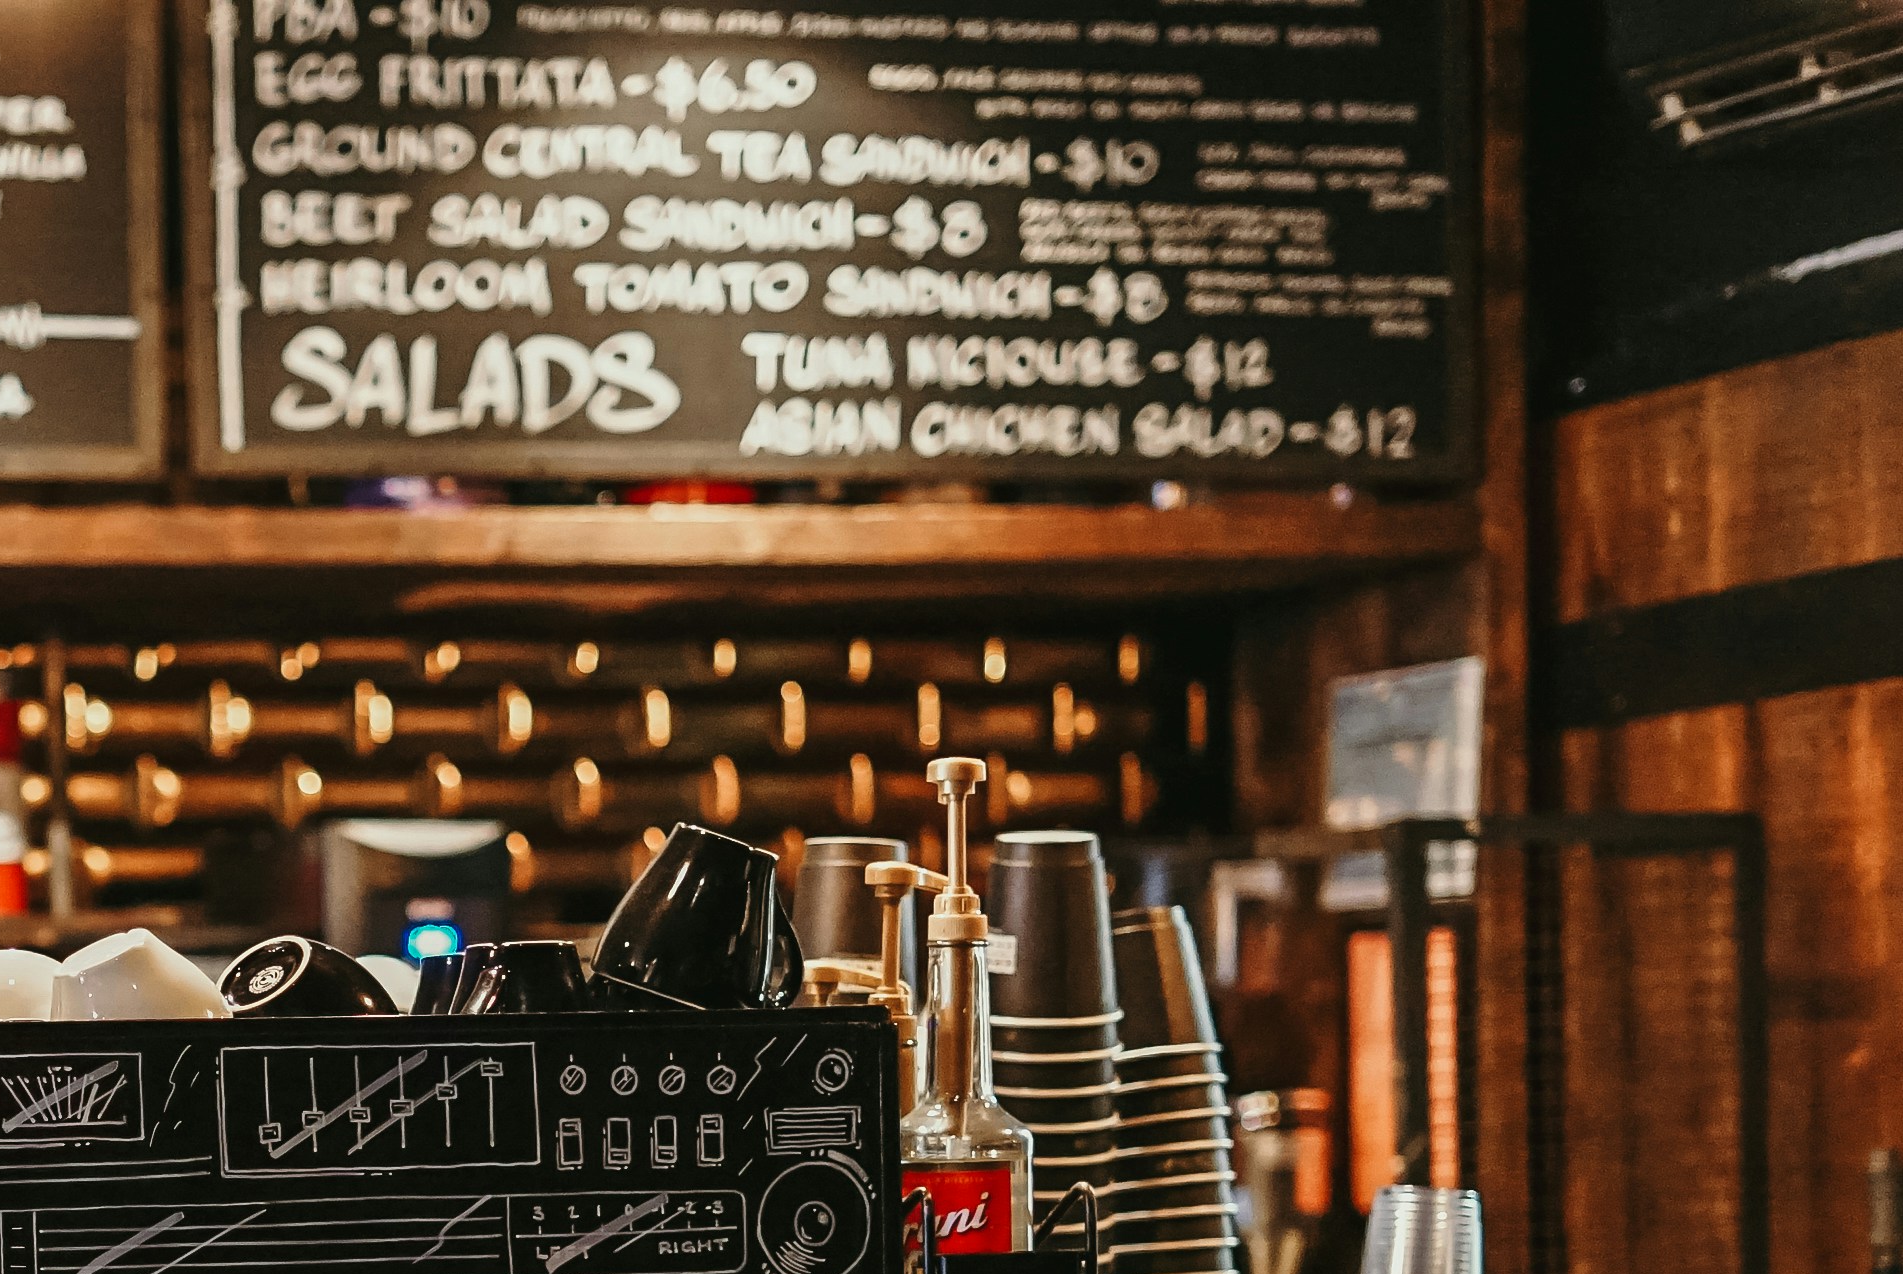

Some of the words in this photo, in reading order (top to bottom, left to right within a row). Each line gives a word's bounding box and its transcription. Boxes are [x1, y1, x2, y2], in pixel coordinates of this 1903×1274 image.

[253, 51, 363, 108] EGG
[252, 120, 478, 177] GROUND
[483, 121, 699, 180] CENTRAL
[704, 128, 812, 184] TEA
[819, 130, 1030, 188] SANDWICH
[260, 188, 409, 247] BEET
[427, 191, 610, 249] SALAD
[618, 195, 855, 252] SANDWICH
[260, 257, 553, 317] HEIRLOOM
[573, 258, 809, 315] TOMATO
[824, 263, 1052, 320] SANDWICH
[270, 325, 682, 437] SALADS
[740, 331, 893, 394] TUNA
[739, 399, 902, 458] ASIAN
[911, 401, 1120, 458] CHICKEN
[1133, 402, 1284, 458] SALAD
[532, 1206, 545, 1221] 3
[568, 1205, 580, 1219] 2
[658, 1237, 729, 1255] RIGHT
